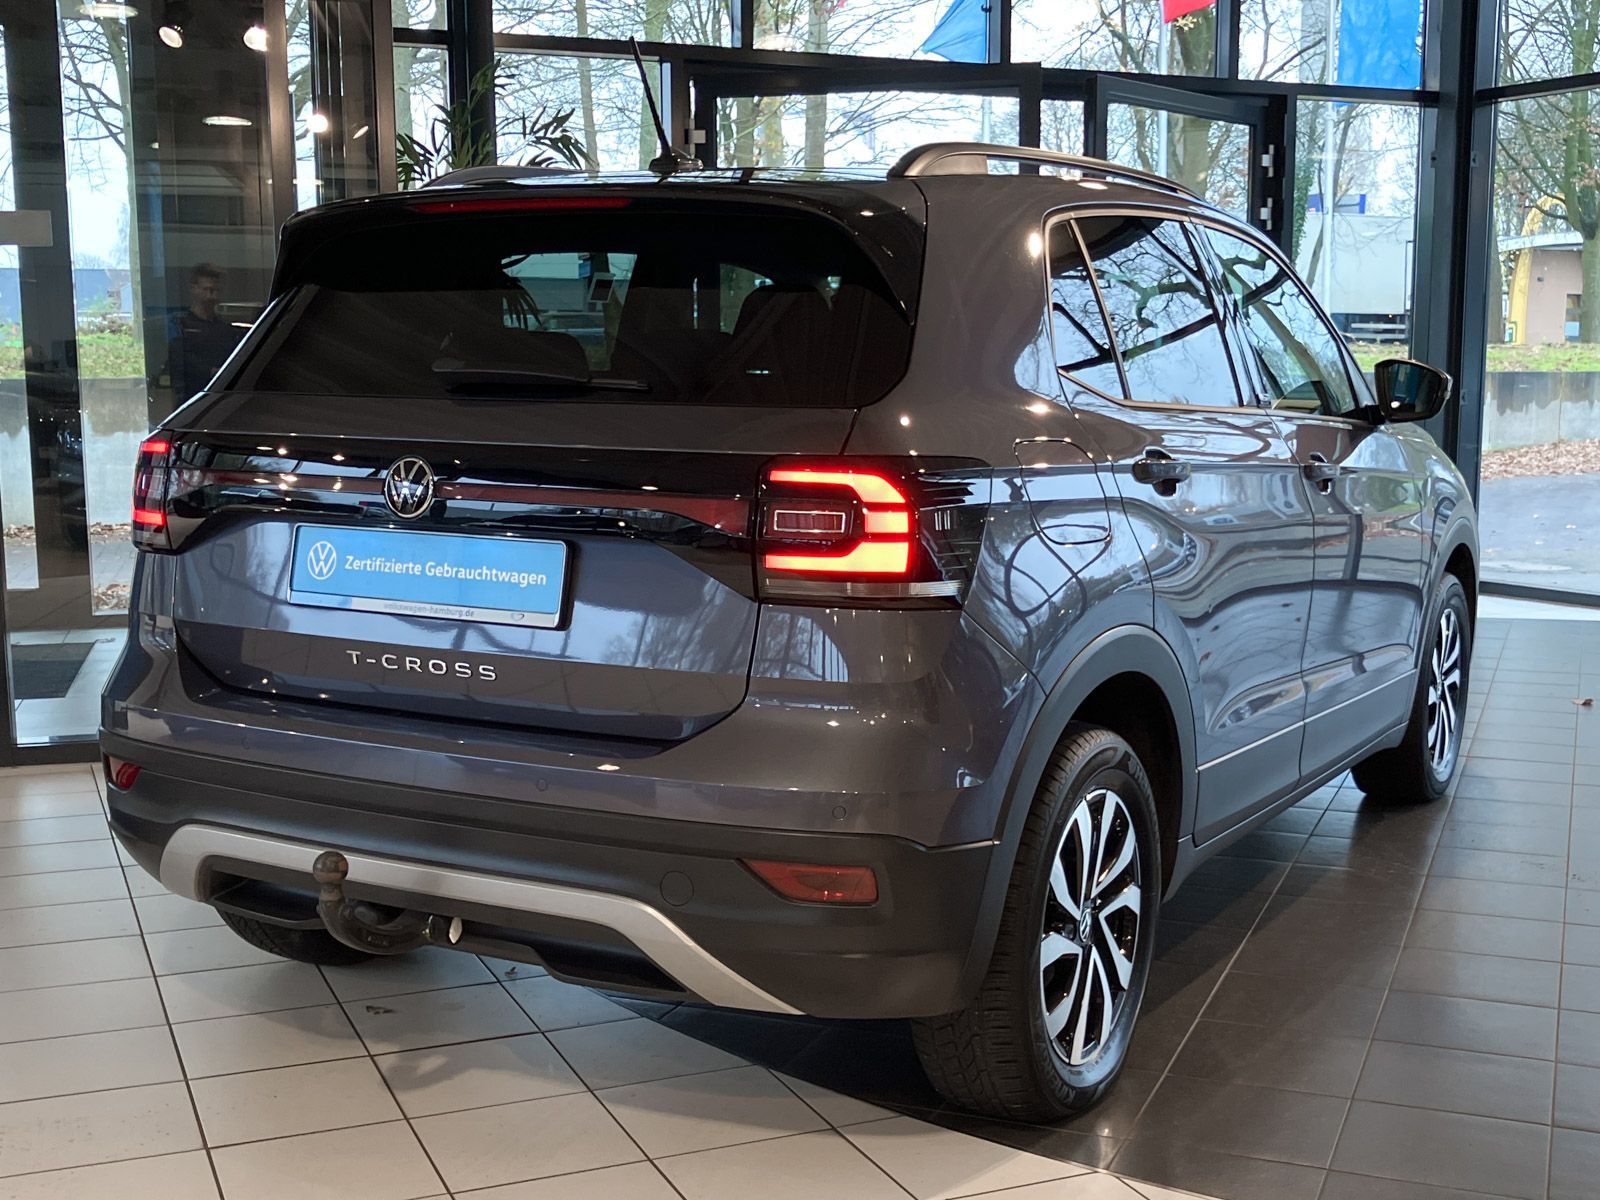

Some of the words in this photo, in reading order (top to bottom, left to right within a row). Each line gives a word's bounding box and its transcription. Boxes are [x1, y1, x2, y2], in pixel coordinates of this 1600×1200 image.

[344, 555, 422, 576] Zertifizierte
[425, 562, 547, 587] Gebrauchtwagen
[346, 650, 498, 681] T-CROSS
